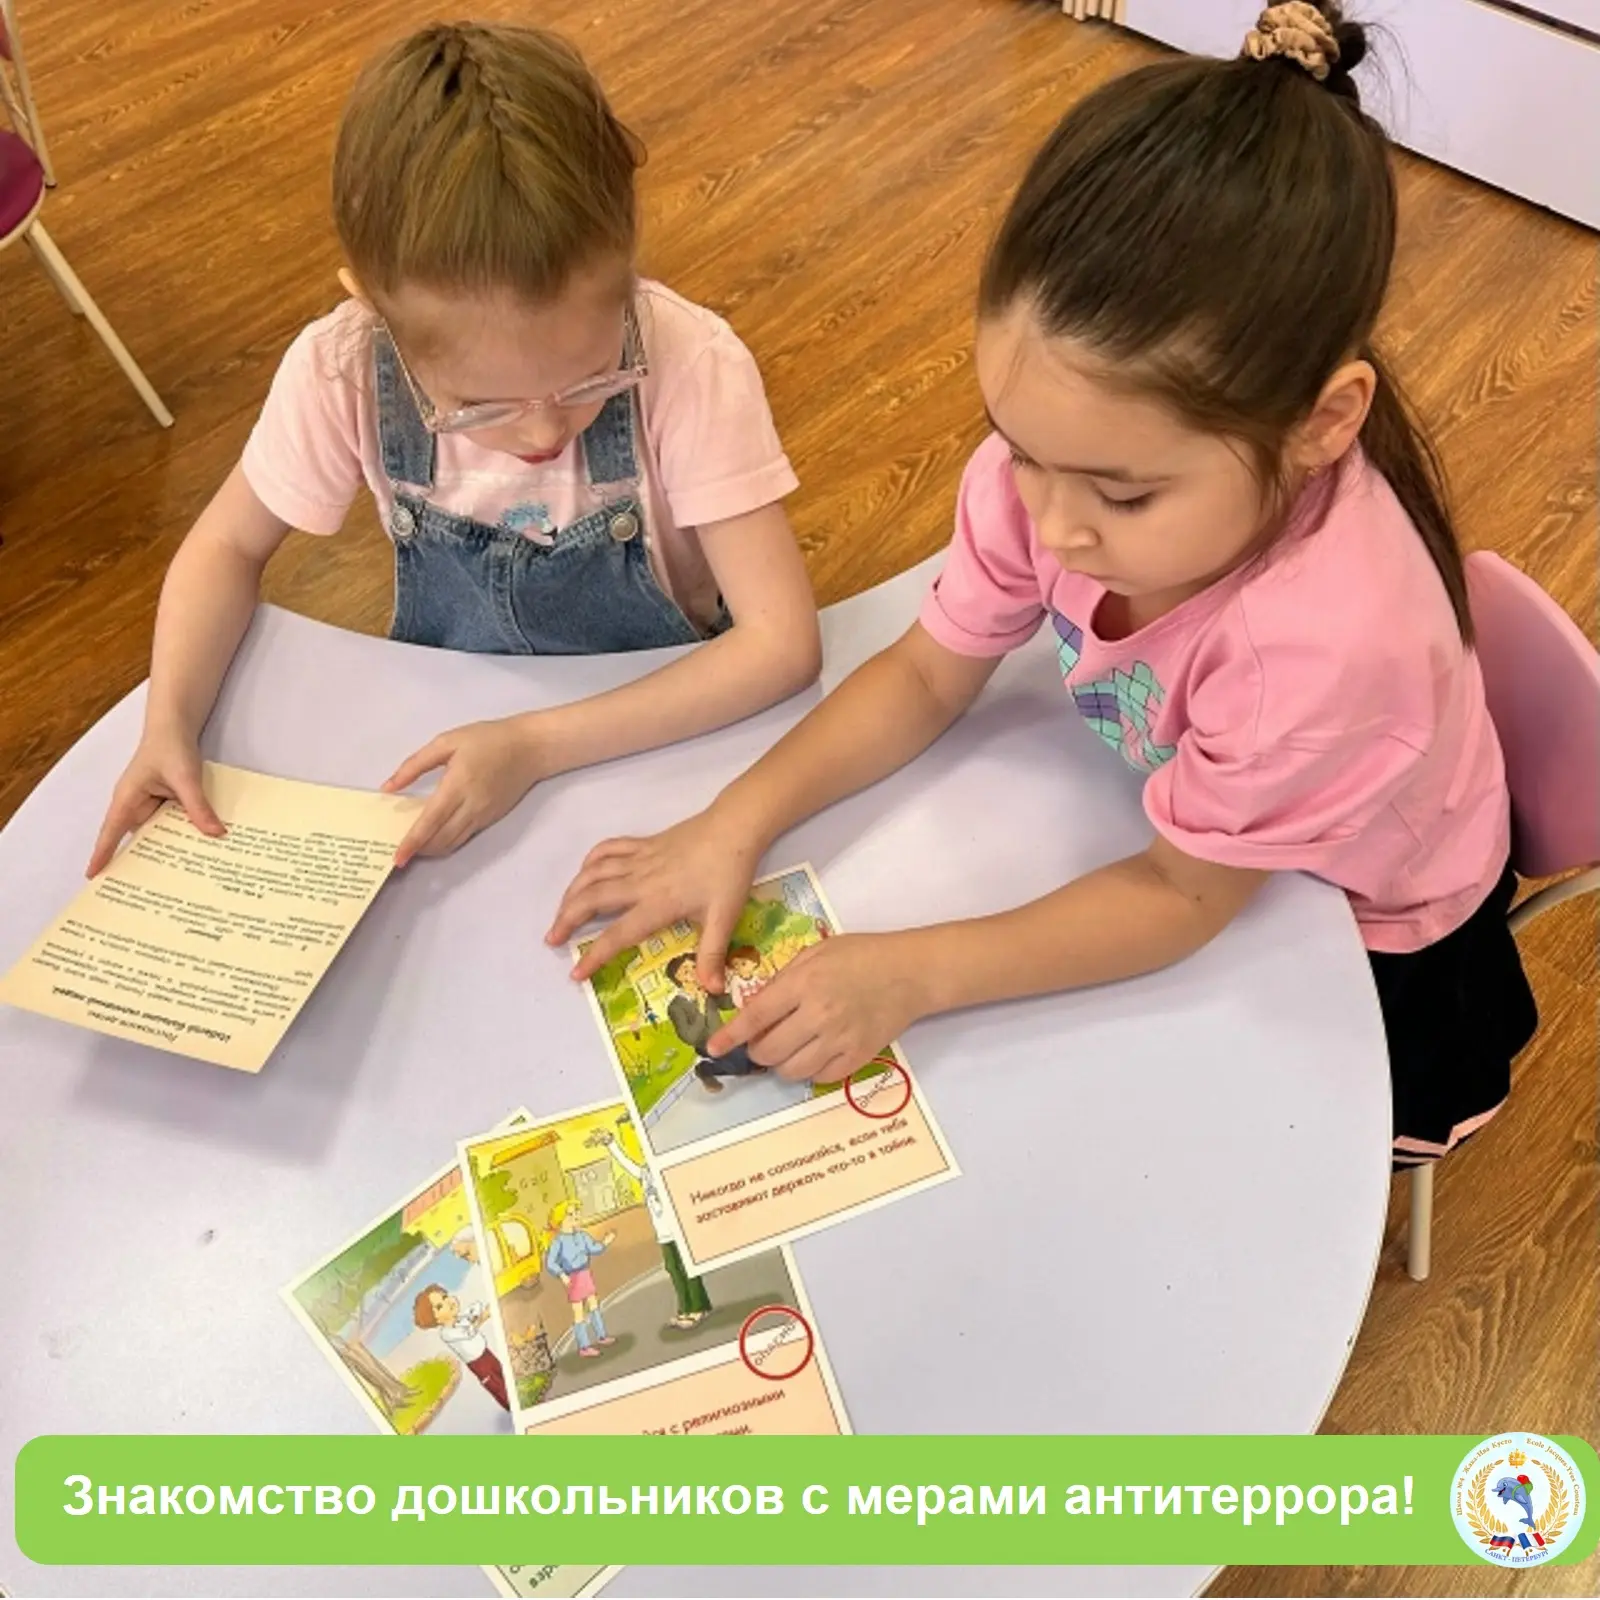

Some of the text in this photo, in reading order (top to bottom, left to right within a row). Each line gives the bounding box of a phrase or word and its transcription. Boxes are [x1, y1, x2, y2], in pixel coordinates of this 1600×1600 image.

[690, 1117, 909, 1205] Никогда не соглашайся, если тебя
[696, 1190, 770, 1224] заставляют
[771, 1171, 826, 1196] держать
[827, 1153, 867, 1175] что-то
[869, 1150, 878, 1160] в
[669, 1388, 786, 1435] с религиозными
